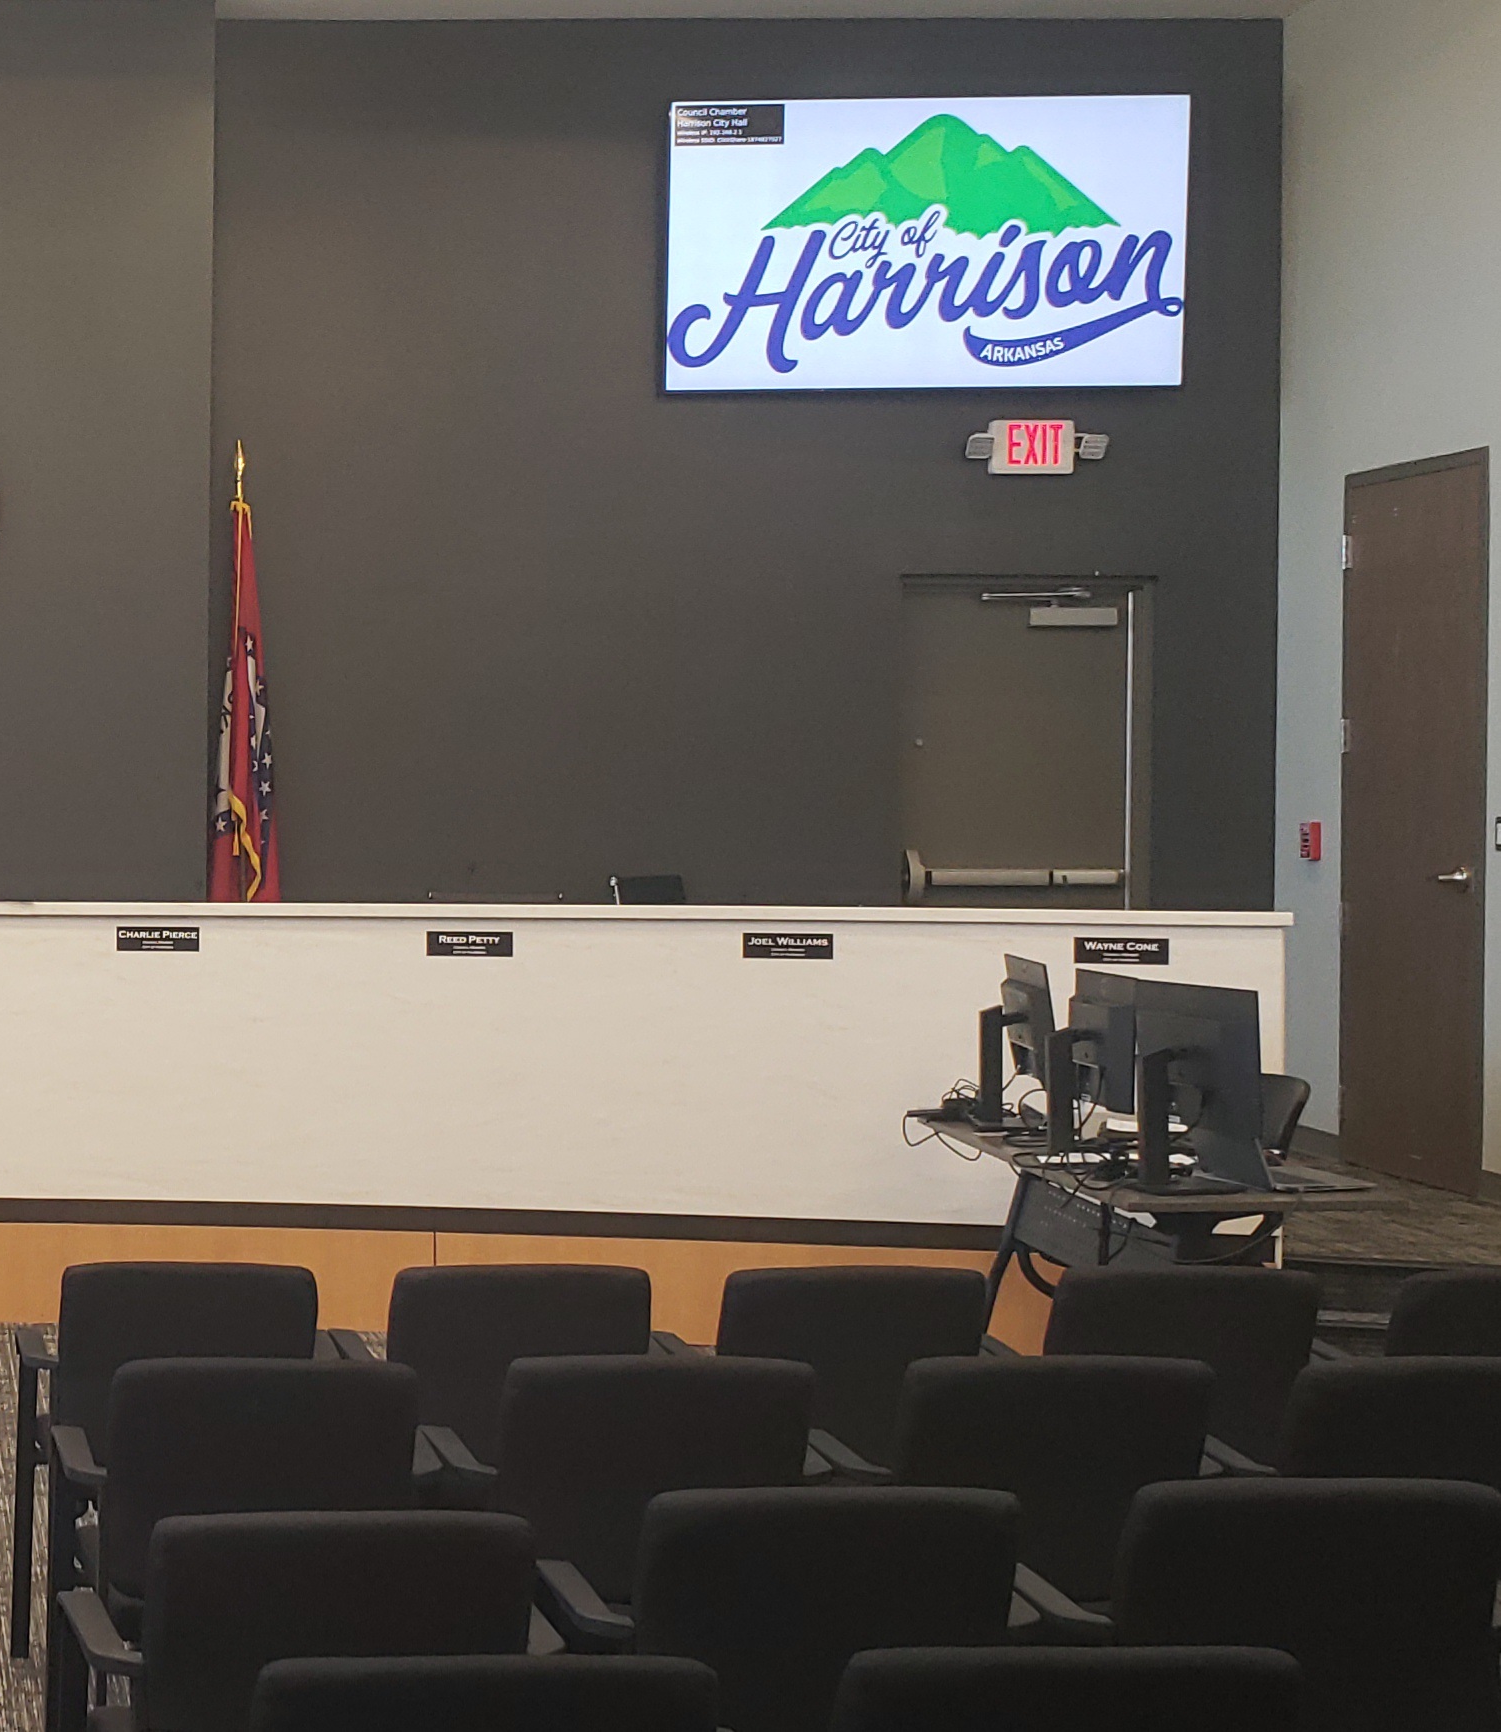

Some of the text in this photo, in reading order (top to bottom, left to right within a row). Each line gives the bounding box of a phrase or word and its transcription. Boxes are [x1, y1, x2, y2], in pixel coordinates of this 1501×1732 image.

[677, 108, 747, 116] Council Chamber
[677, 118, 748, 128] Harrison City Hall
[829, 210, 940, 269] City of
[667, 225, 1183, 372] Harrison
[980, 337, 1065, 362] ARKANSAS
[1007, 424, 1063, 465] EXIT
[118, 930, 198, 939] CHARLIE PIERCE
[439, 935, 500, 944] REED PETTY
[748, 936, 829, 946] JOEL WILLIAMS
[1084, 941, 1159, 951] WAYNE CONE
